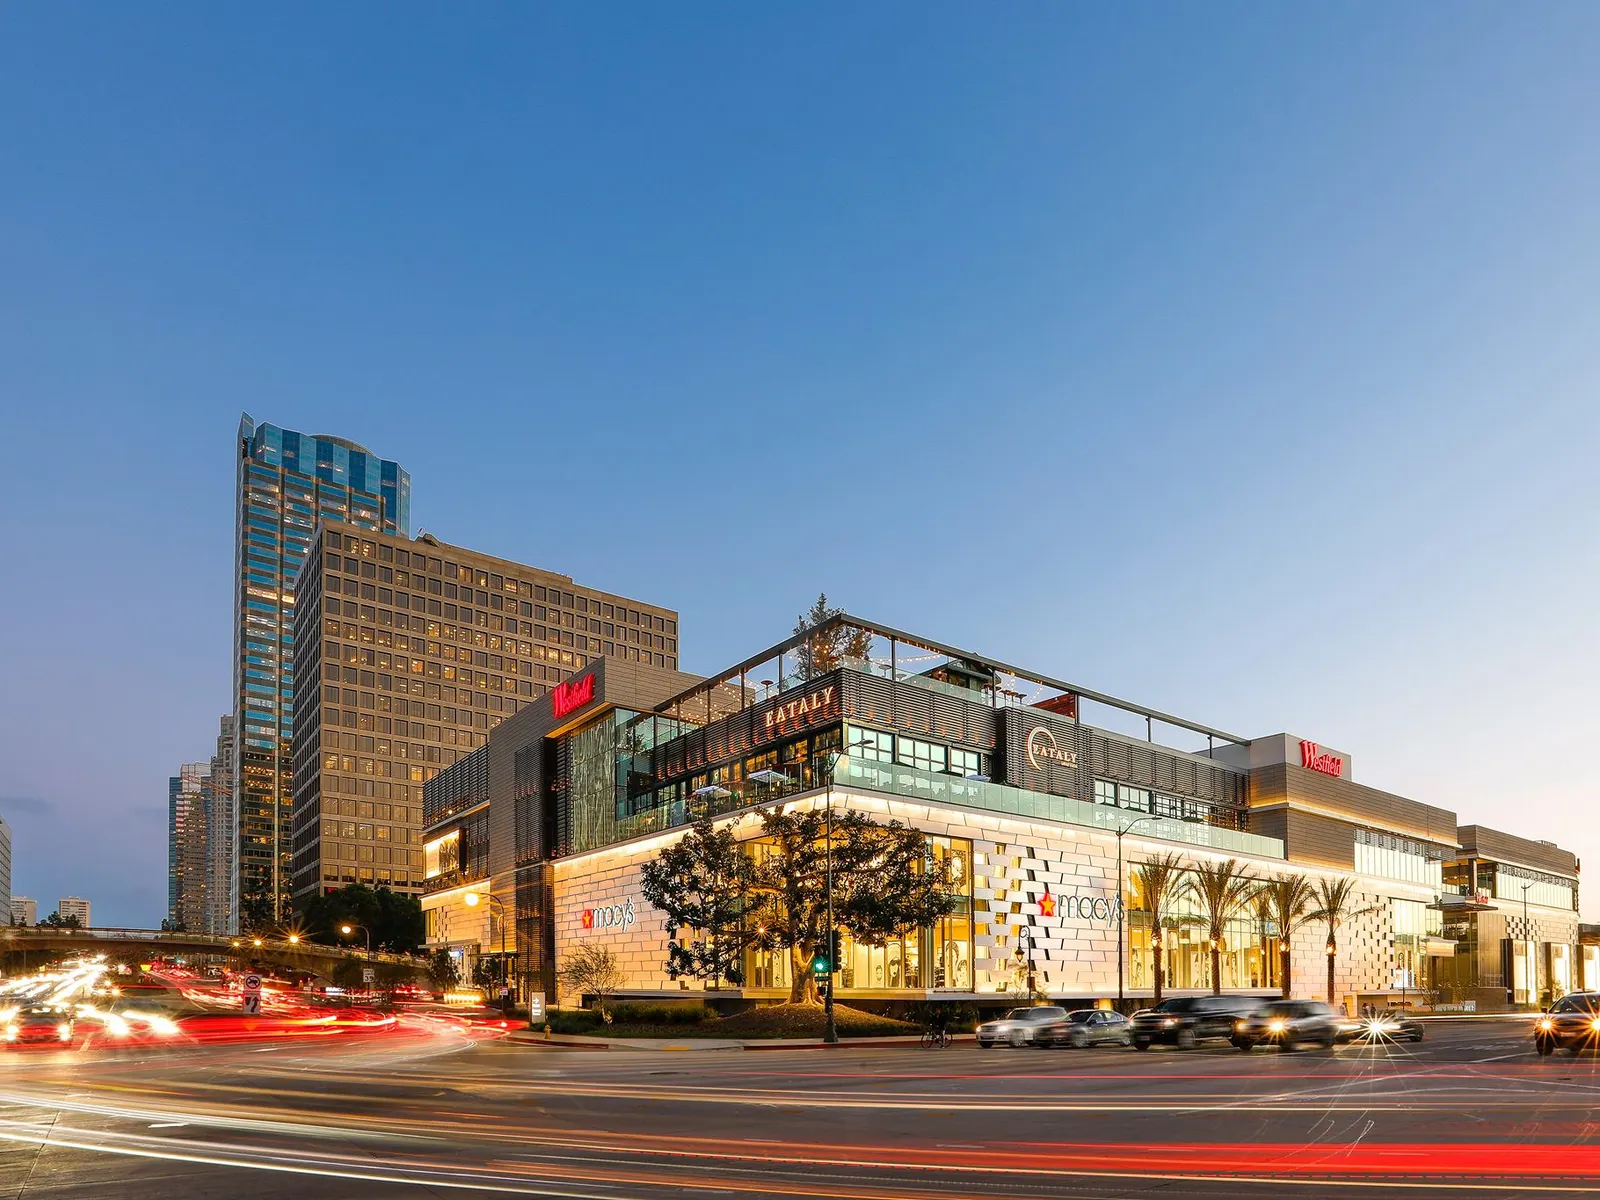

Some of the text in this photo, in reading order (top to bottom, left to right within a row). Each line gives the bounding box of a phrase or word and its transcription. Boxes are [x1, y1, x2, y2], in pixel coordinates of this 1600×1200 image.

[765, 686, 833, 727] EATALY
[1032, 743, 1077, 762] EATALY
[1299, 740, 1342, 778] Westfield
[592, 895, 635, 933] macy's
[1058, 892, 1125, 928] macy's
